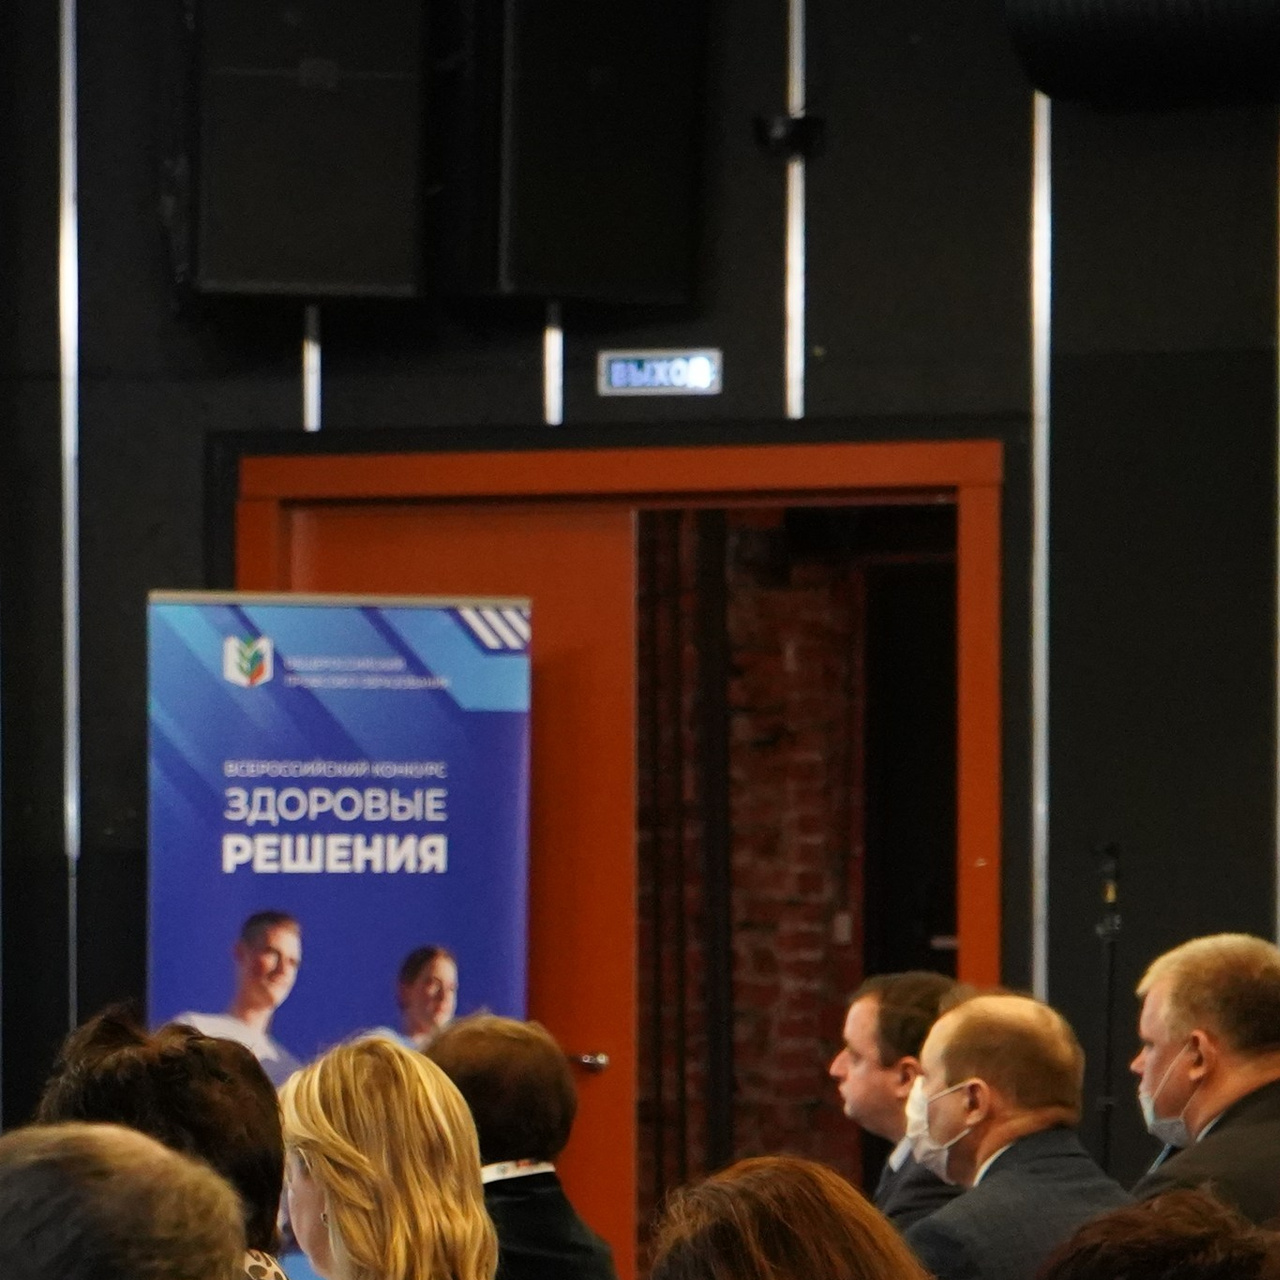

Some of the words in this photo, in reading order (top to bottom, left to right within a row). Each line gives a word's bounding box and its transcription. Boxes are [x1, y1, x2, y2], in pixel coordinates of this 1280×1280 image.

[224, 759, 370, 778] ВСЕРОССИЙСКИЙ
[371, 761, 448, 779] КОНКУРС
[223, 786, 449, 826] ЗДОРОВЫЕ
[222, 833, 448, 874] РЕШЕНИЯ
